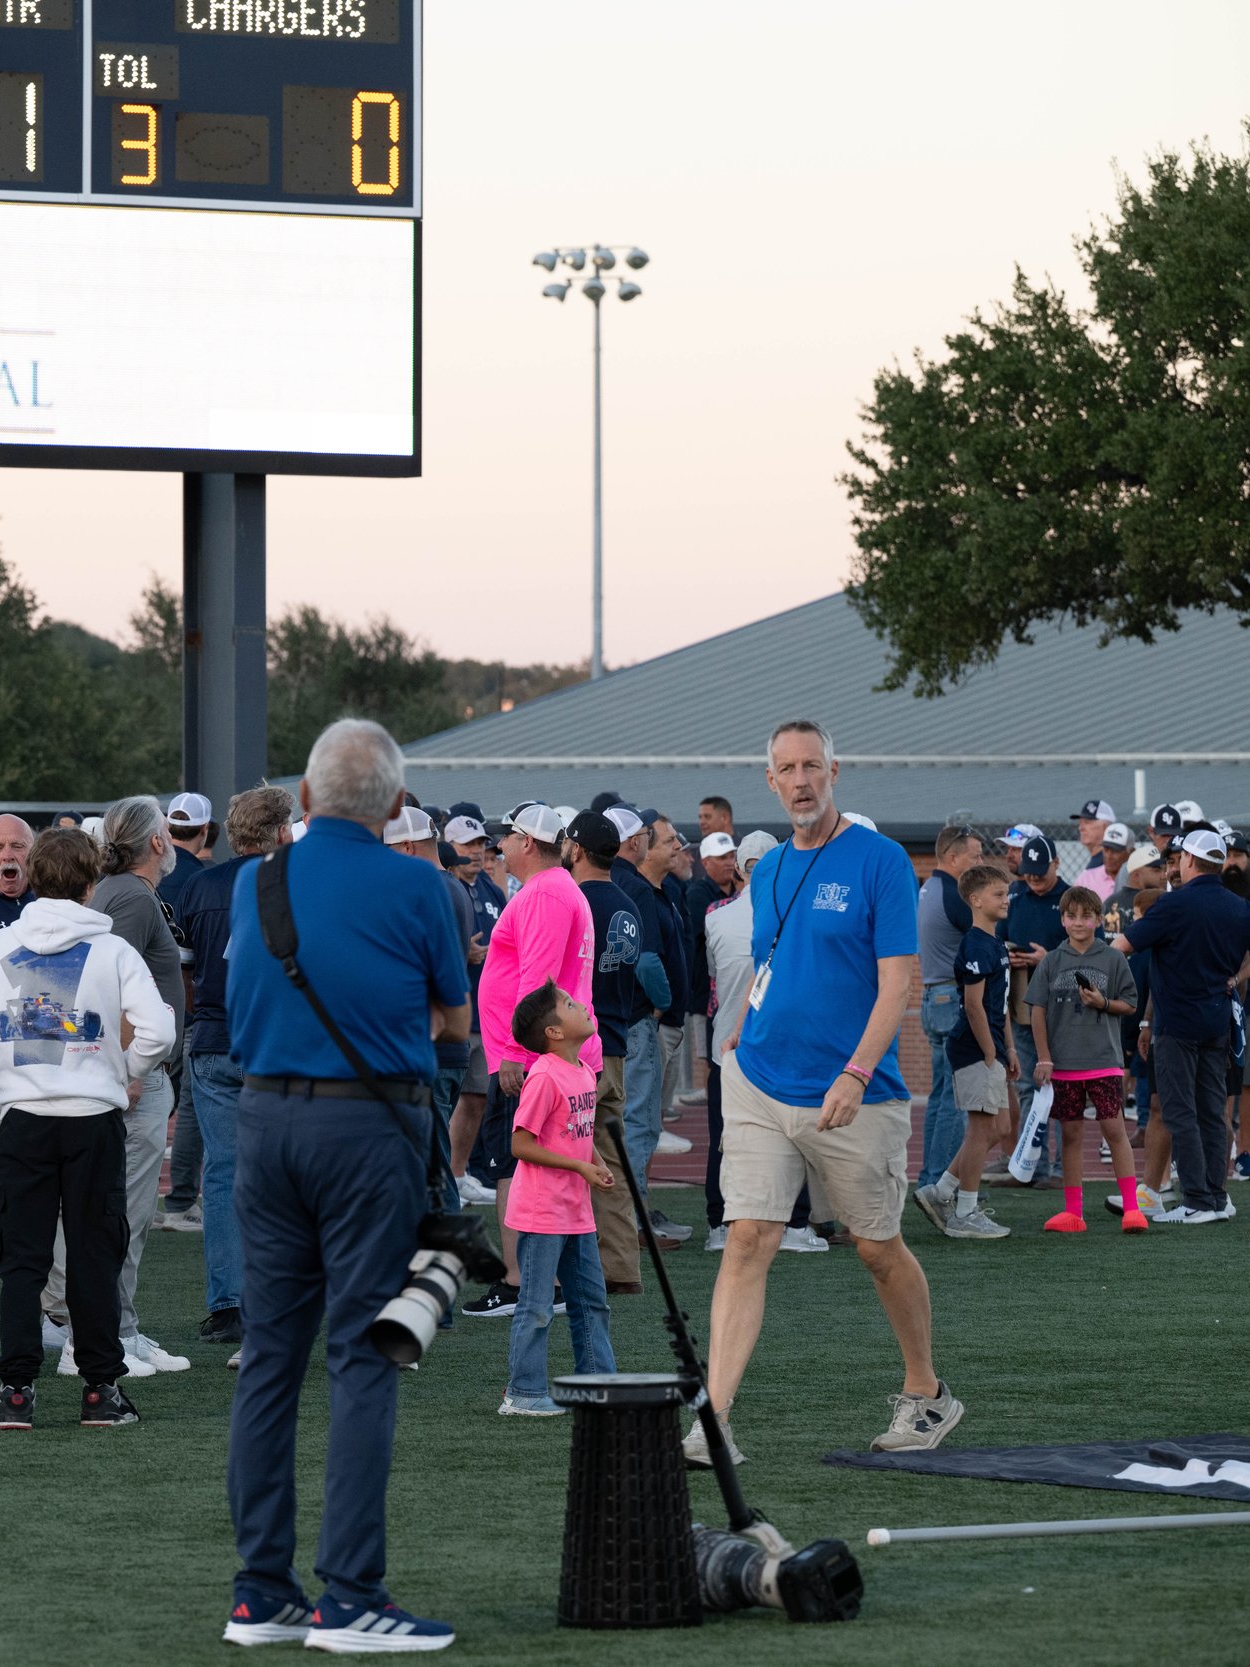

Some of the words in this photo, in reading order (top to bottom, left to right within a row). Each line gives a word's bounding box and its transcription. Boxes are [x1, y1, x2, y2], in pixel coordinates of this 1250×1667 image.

[186, 0, 366, 38] CHARGERS
[99, 53, 158, 90] TOL
[25, 82, 36, 172] 1
[120, 104, 158, 185] 3
[350, 90, 400, 196] 0
[623, 920, 637, 938] 30
